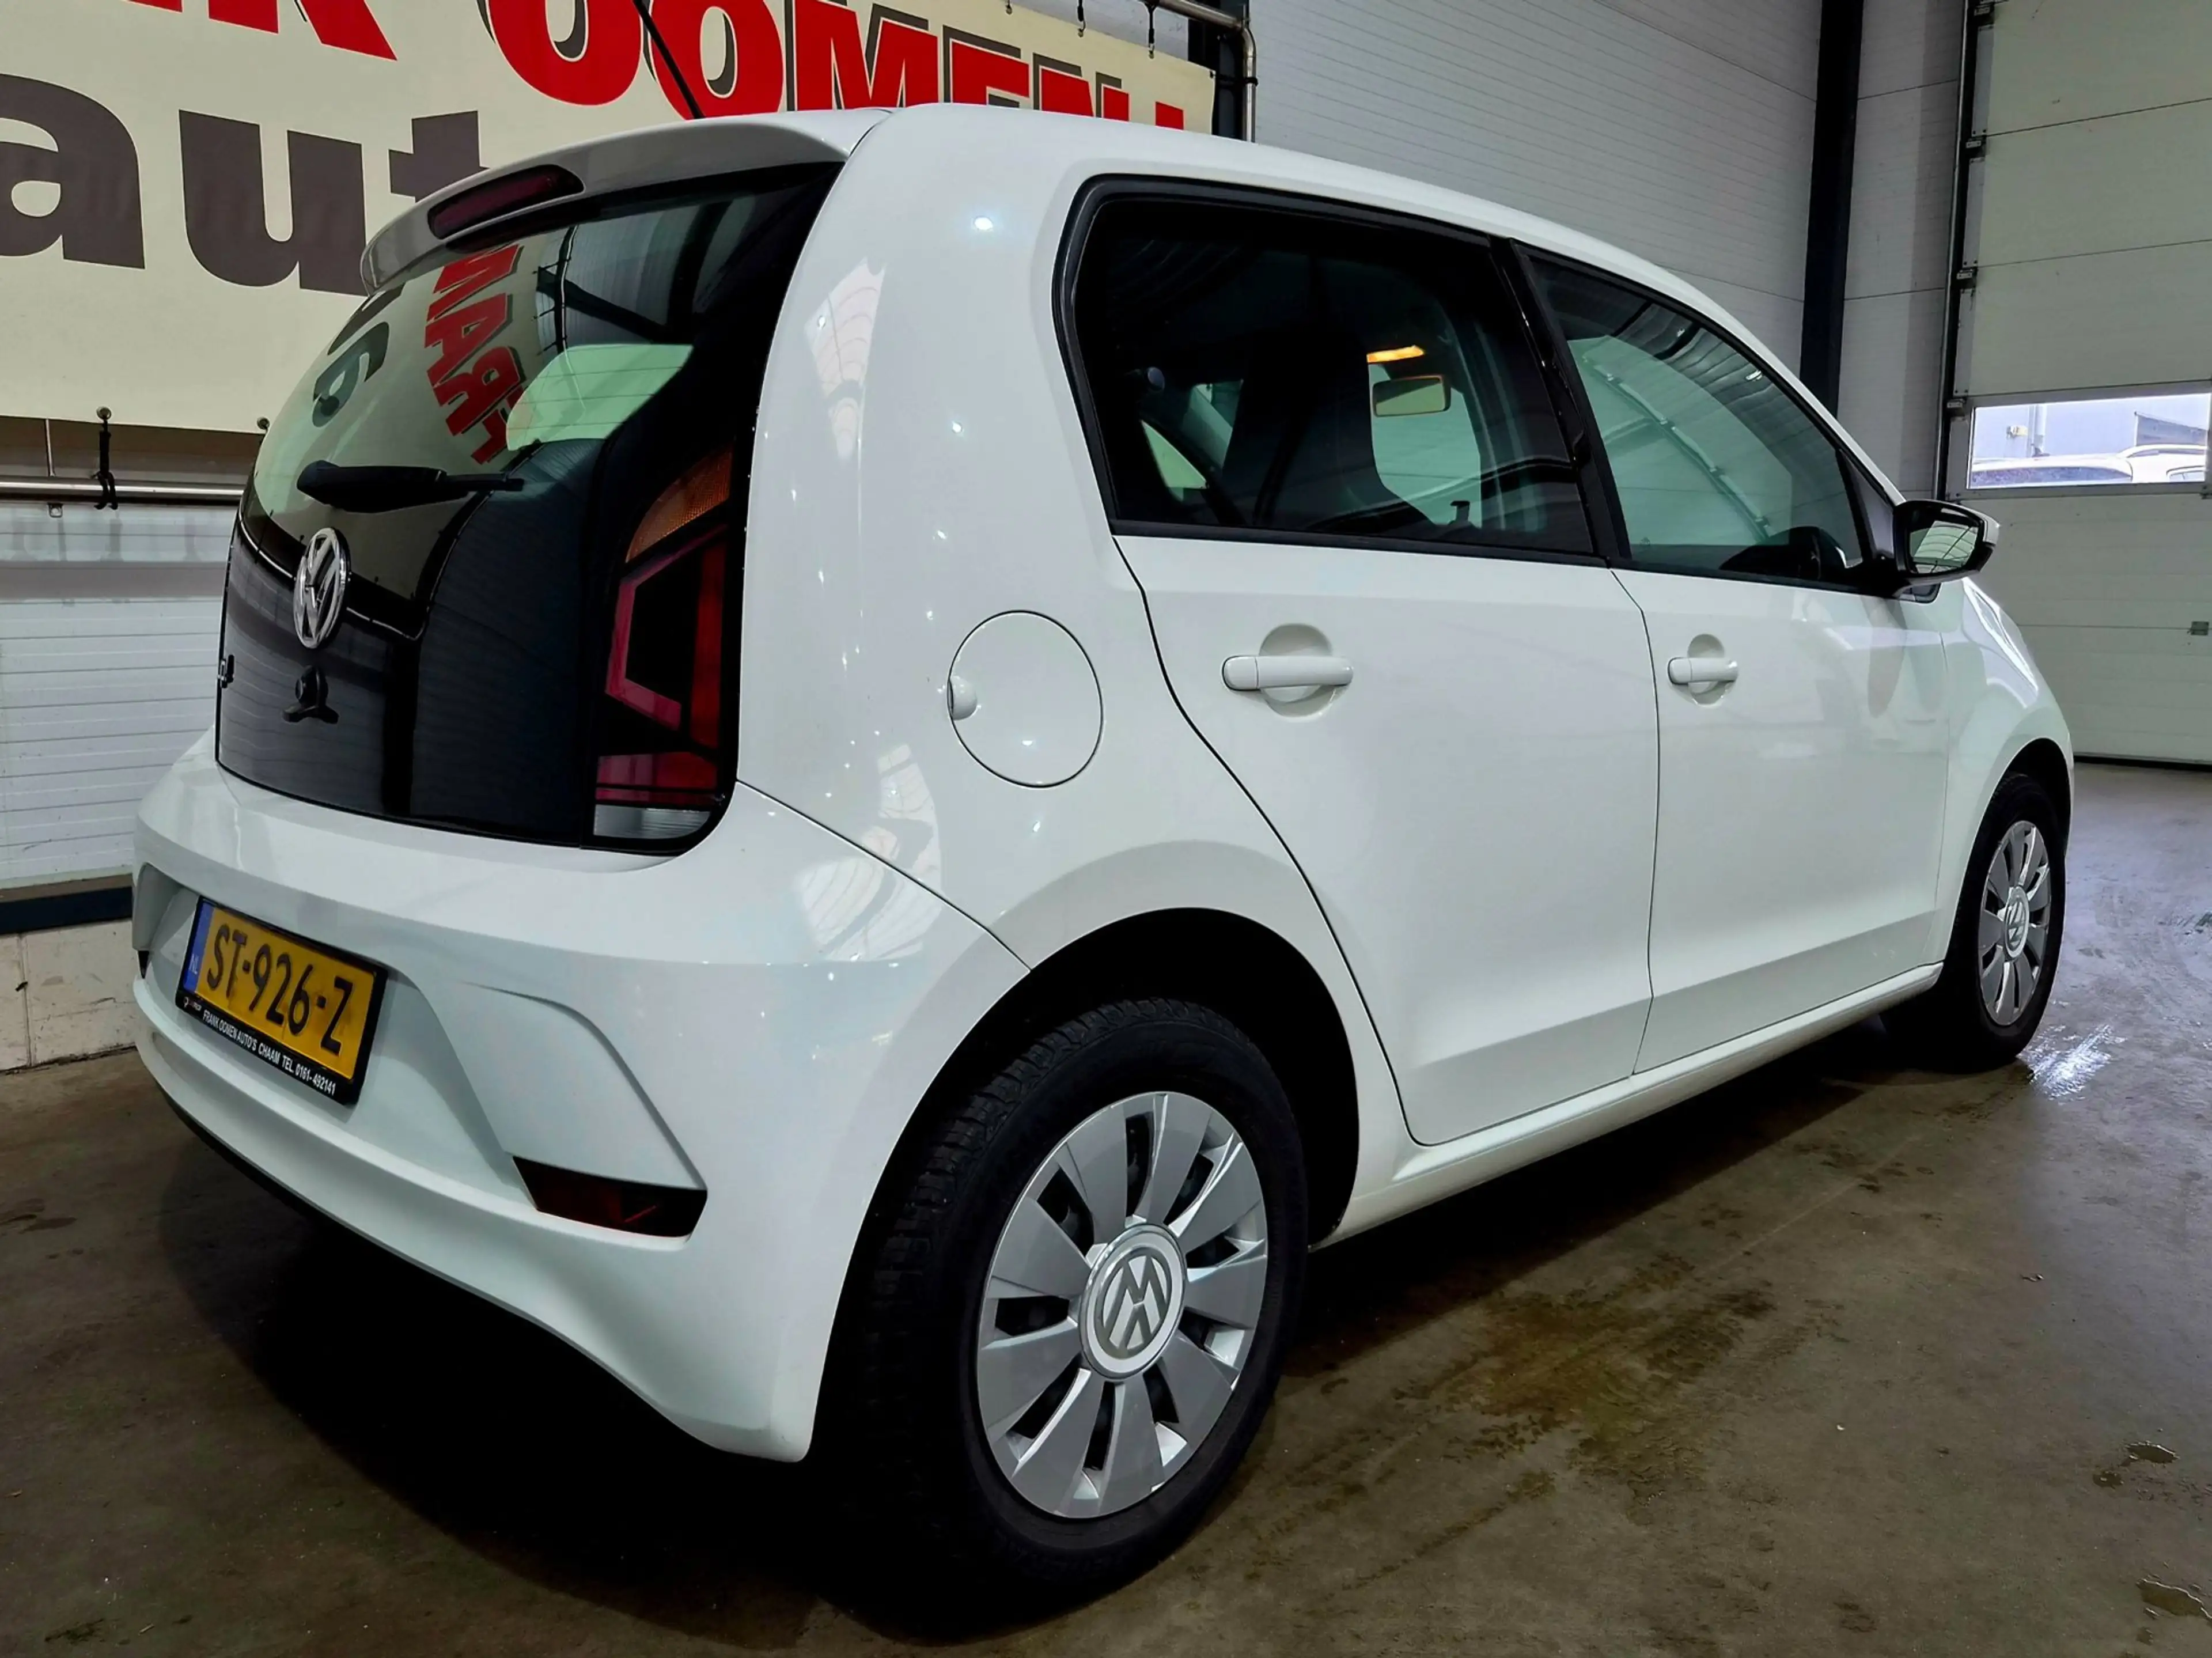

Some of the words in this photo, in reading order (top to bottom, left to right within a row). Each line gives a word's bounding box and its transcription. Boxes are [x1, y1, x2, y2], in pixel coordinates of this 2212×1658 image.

[206, 923, 354, 1057] ST-926-Z
[203, 1009, 219, 1028] FRANK
[219, 1019, 238, 1039] OOMEN
[236, 1030, 257, 1051] AUTO'S
[258, 1042, 281, 1064] CHAAM
[295, 1063, 336, 1096] 0161-492141
